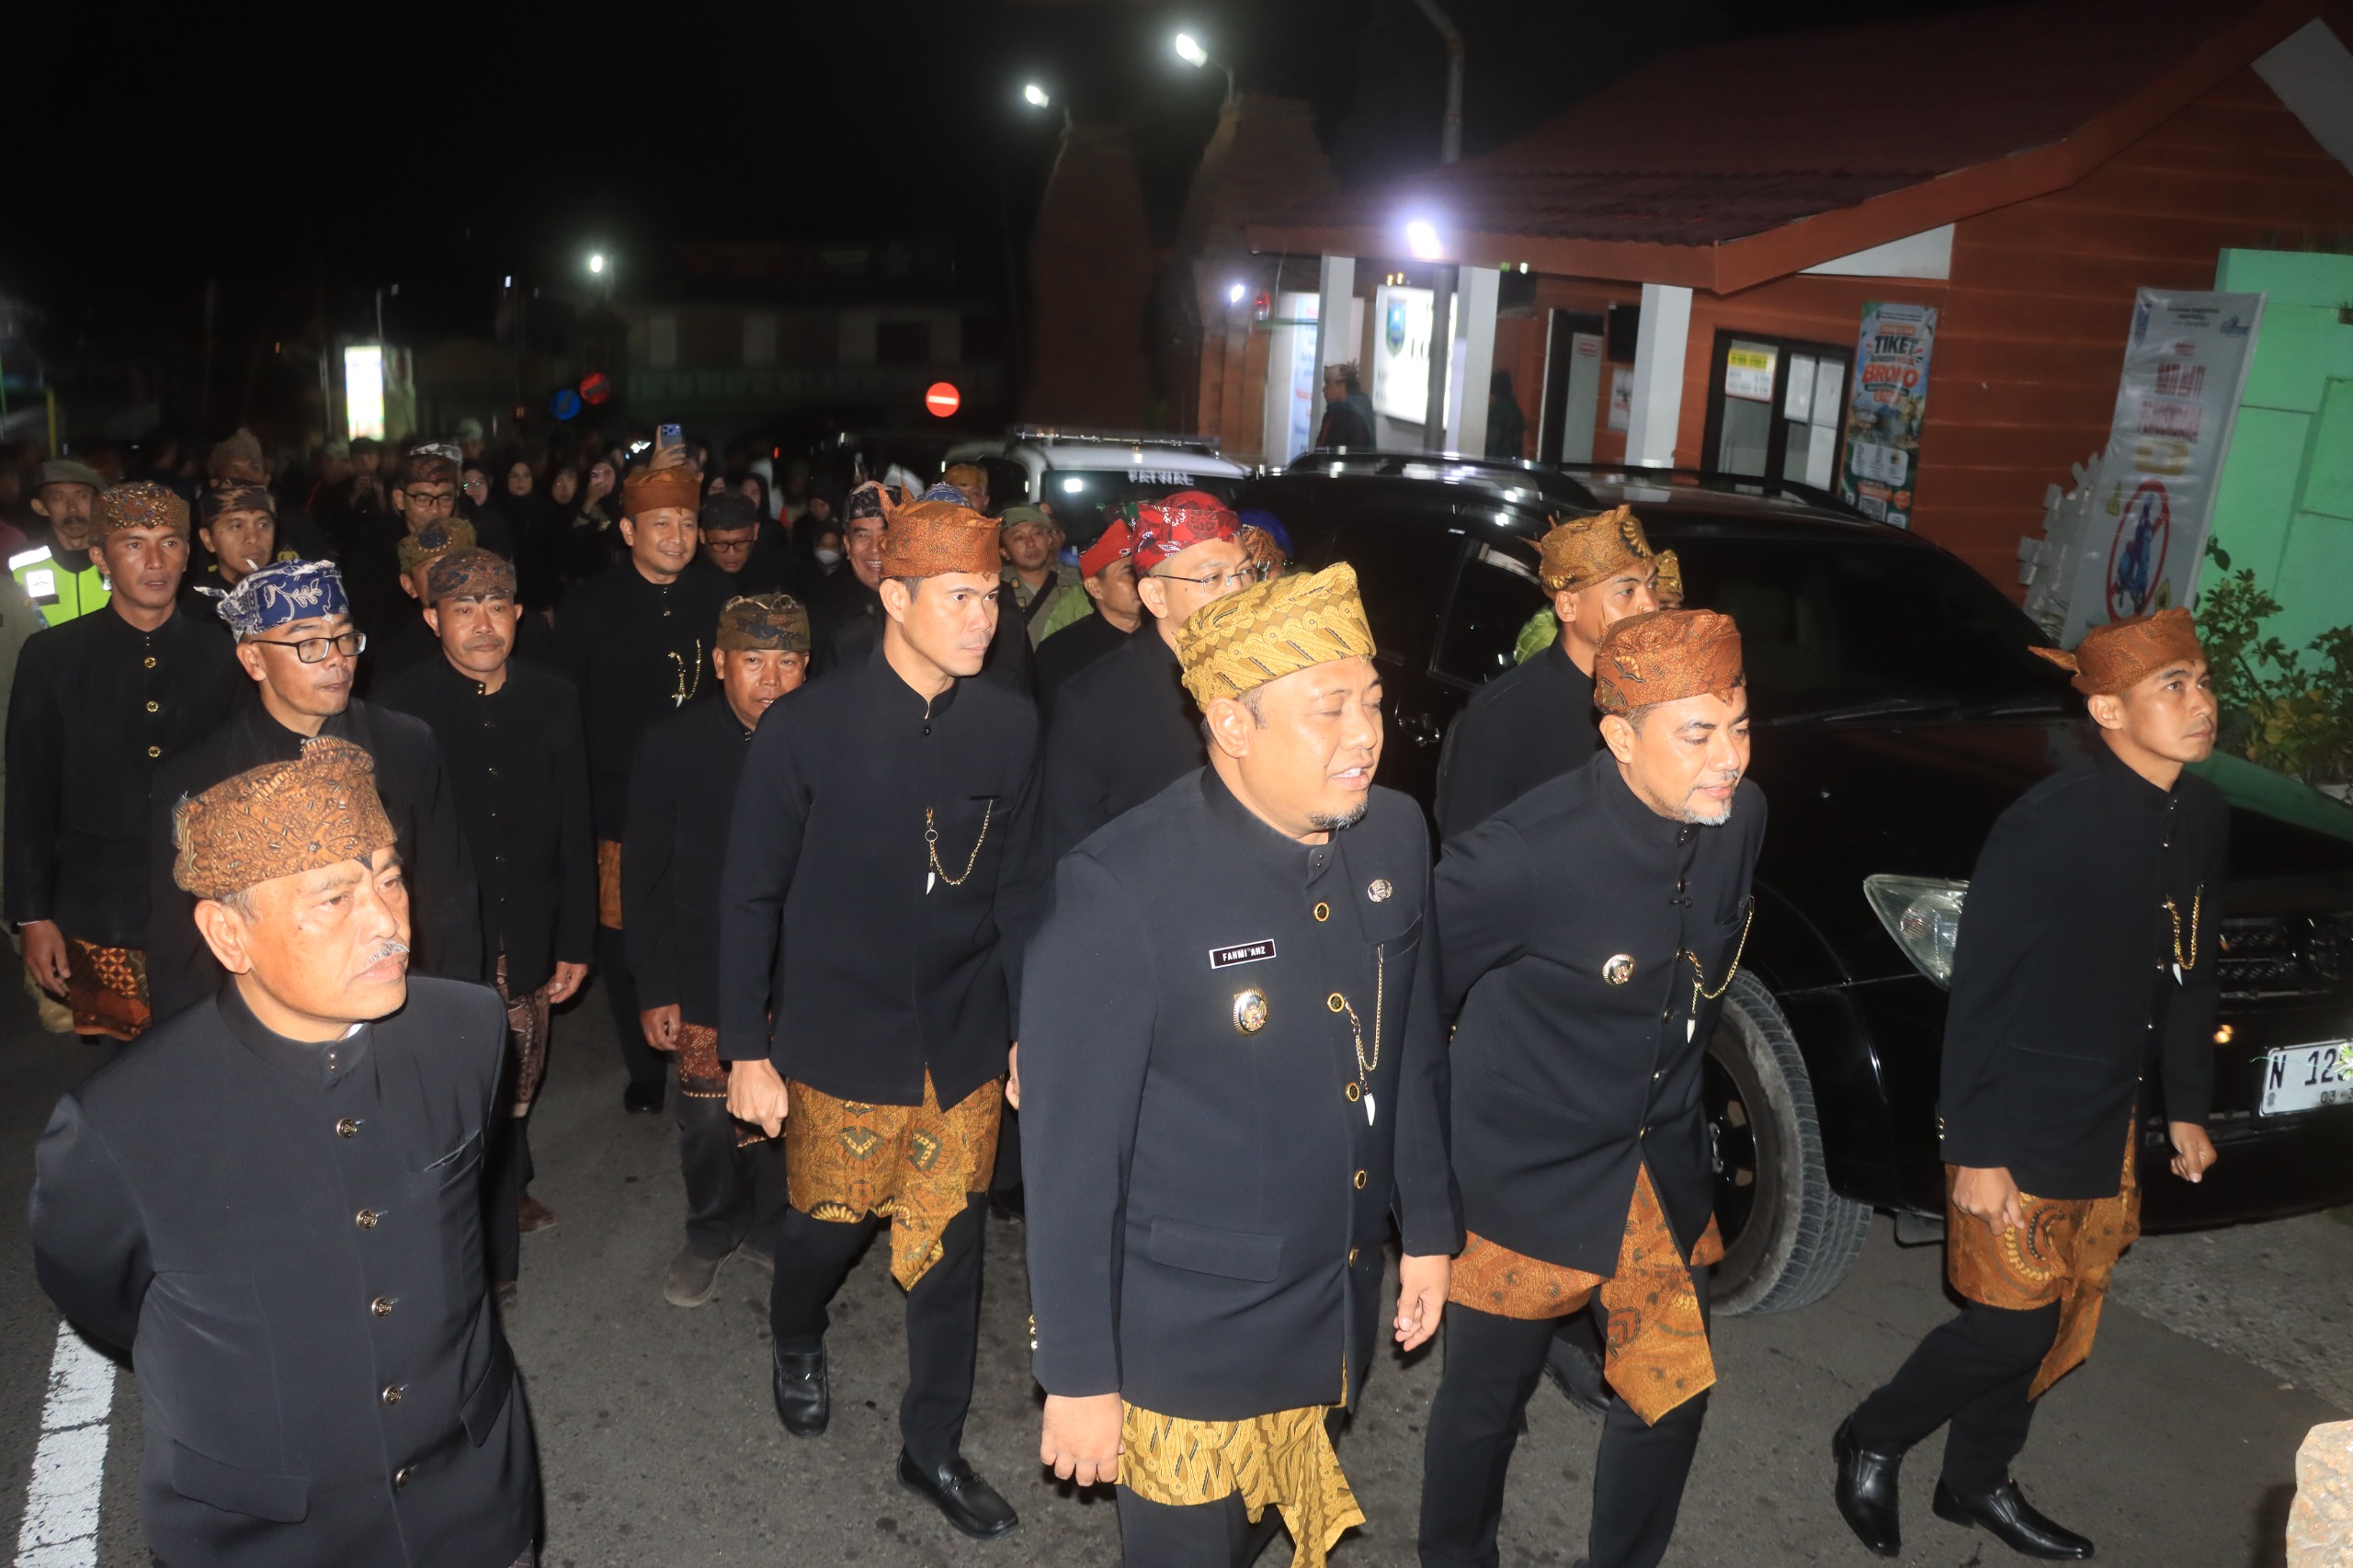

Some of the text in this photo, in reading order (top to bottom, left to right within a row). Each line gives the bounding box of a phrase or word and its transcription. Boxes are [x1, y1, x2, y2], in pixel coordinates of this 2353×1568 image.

[1874, 335, 1920, 356] TIKET
[1222, 946, 1267, 961] FAHMI AHZ
[2268, 1048, 2352, 1090] N 12
